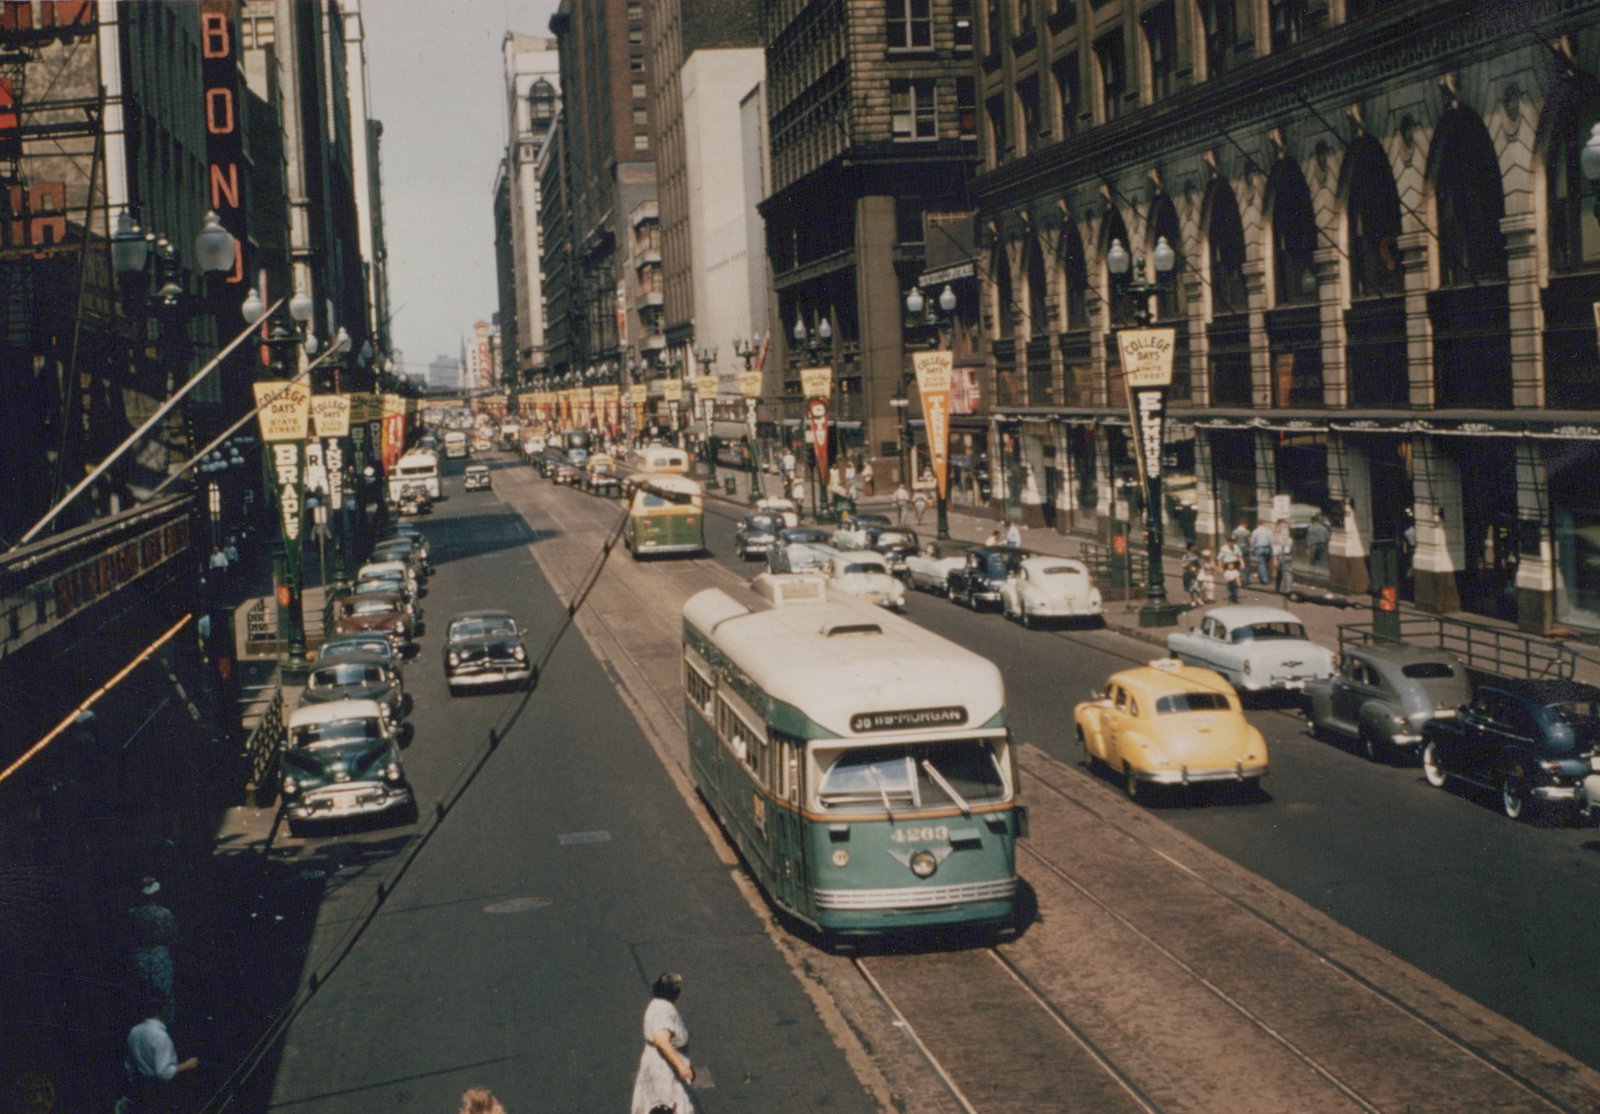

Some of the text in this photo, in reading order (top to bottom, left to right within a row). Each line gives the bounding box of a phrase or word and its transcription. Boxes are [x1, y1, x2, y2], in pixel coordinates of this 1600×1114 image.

[1124, 336, 1171, 355] COLLEGE
[1137, 351, 1161, 361] DAYS
[918, 356, 950, 370] COLLEGE
[271, 403, 296, 414] DAYS
[313, 400, 348, 414] COLLEGE
[322, 410, 341, 418] DAYS
[270, 418, 298, 426] STATE
